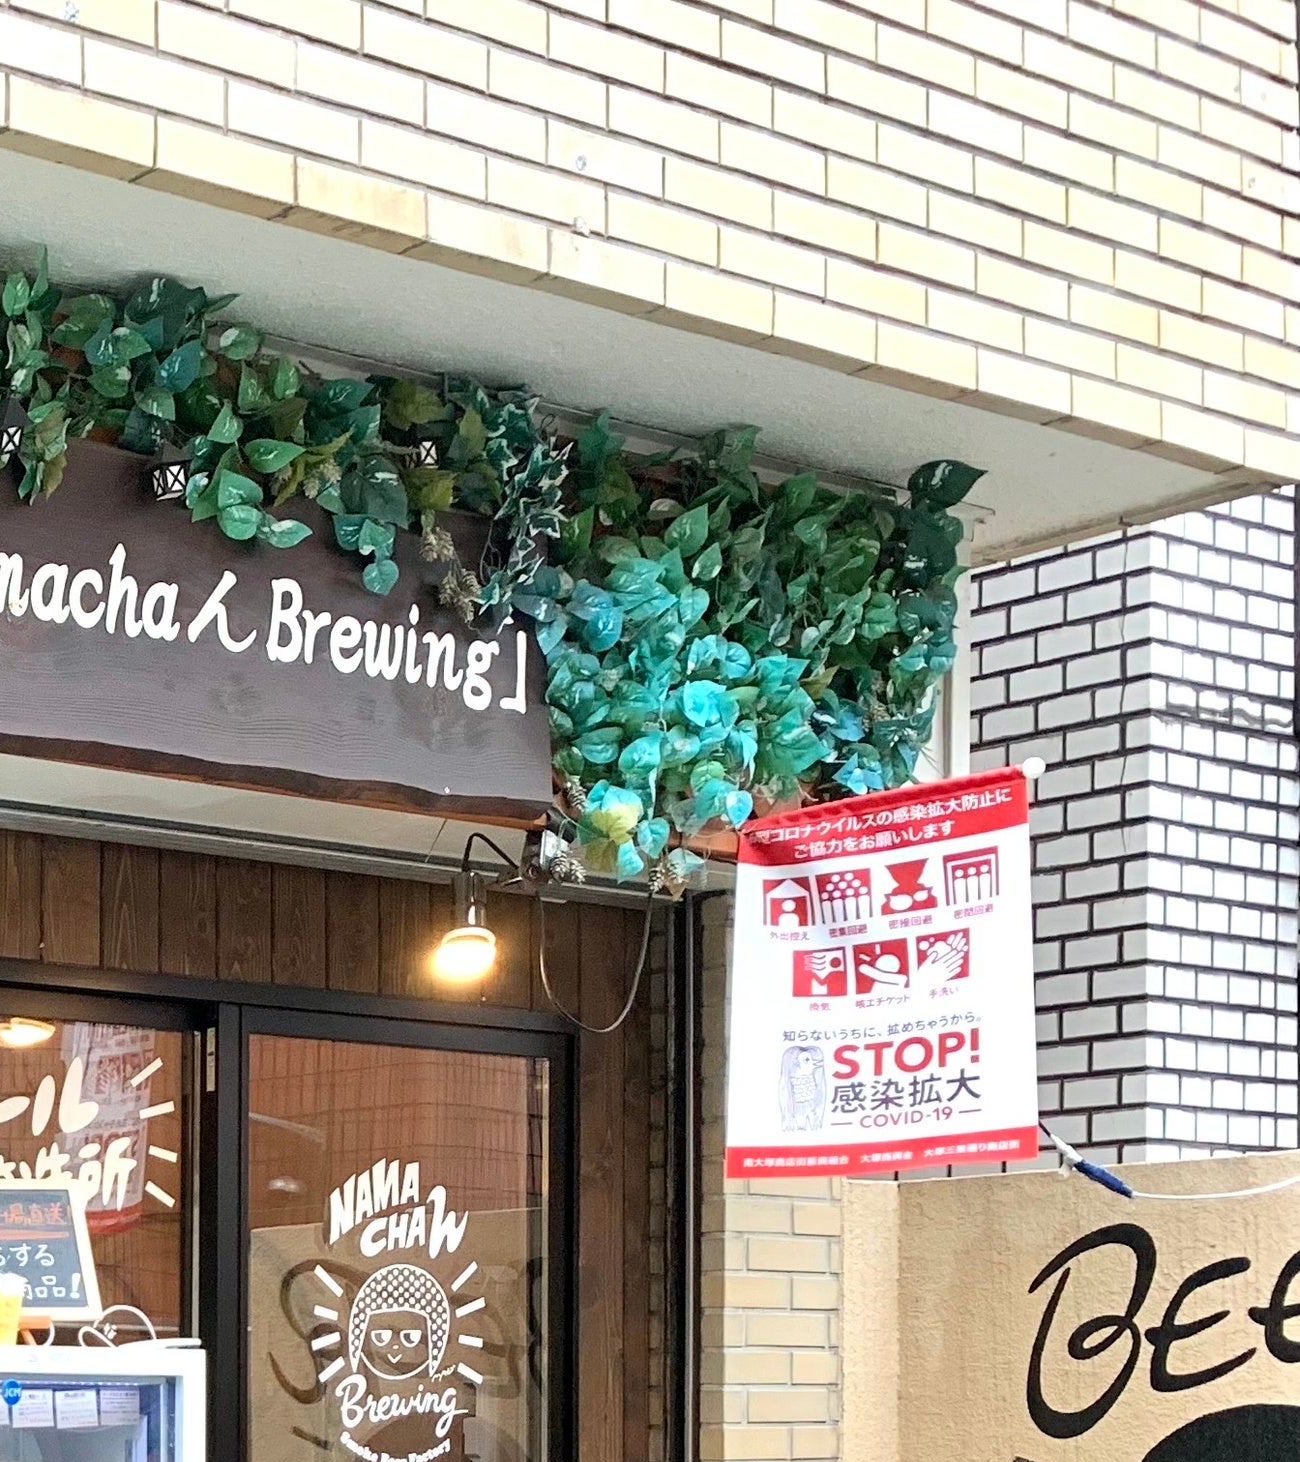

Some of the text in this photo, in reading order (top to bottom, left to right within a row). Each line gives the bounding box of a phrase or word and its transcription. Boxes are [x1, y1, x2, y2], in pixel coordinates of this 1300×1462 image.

[793, 820, 956, 860] ご協力をお願いします
[831, 1027, 981, 1079] STOP!
[830, 1068, 982, 1114] 感染拡大
[859, 1105, 954, 1129] COVID-19
[329, 1157, 420, 1245] NAMA
[335, 1373, 469, 1439] Brewing
[340, 1430, 378, 1462] Smoke
